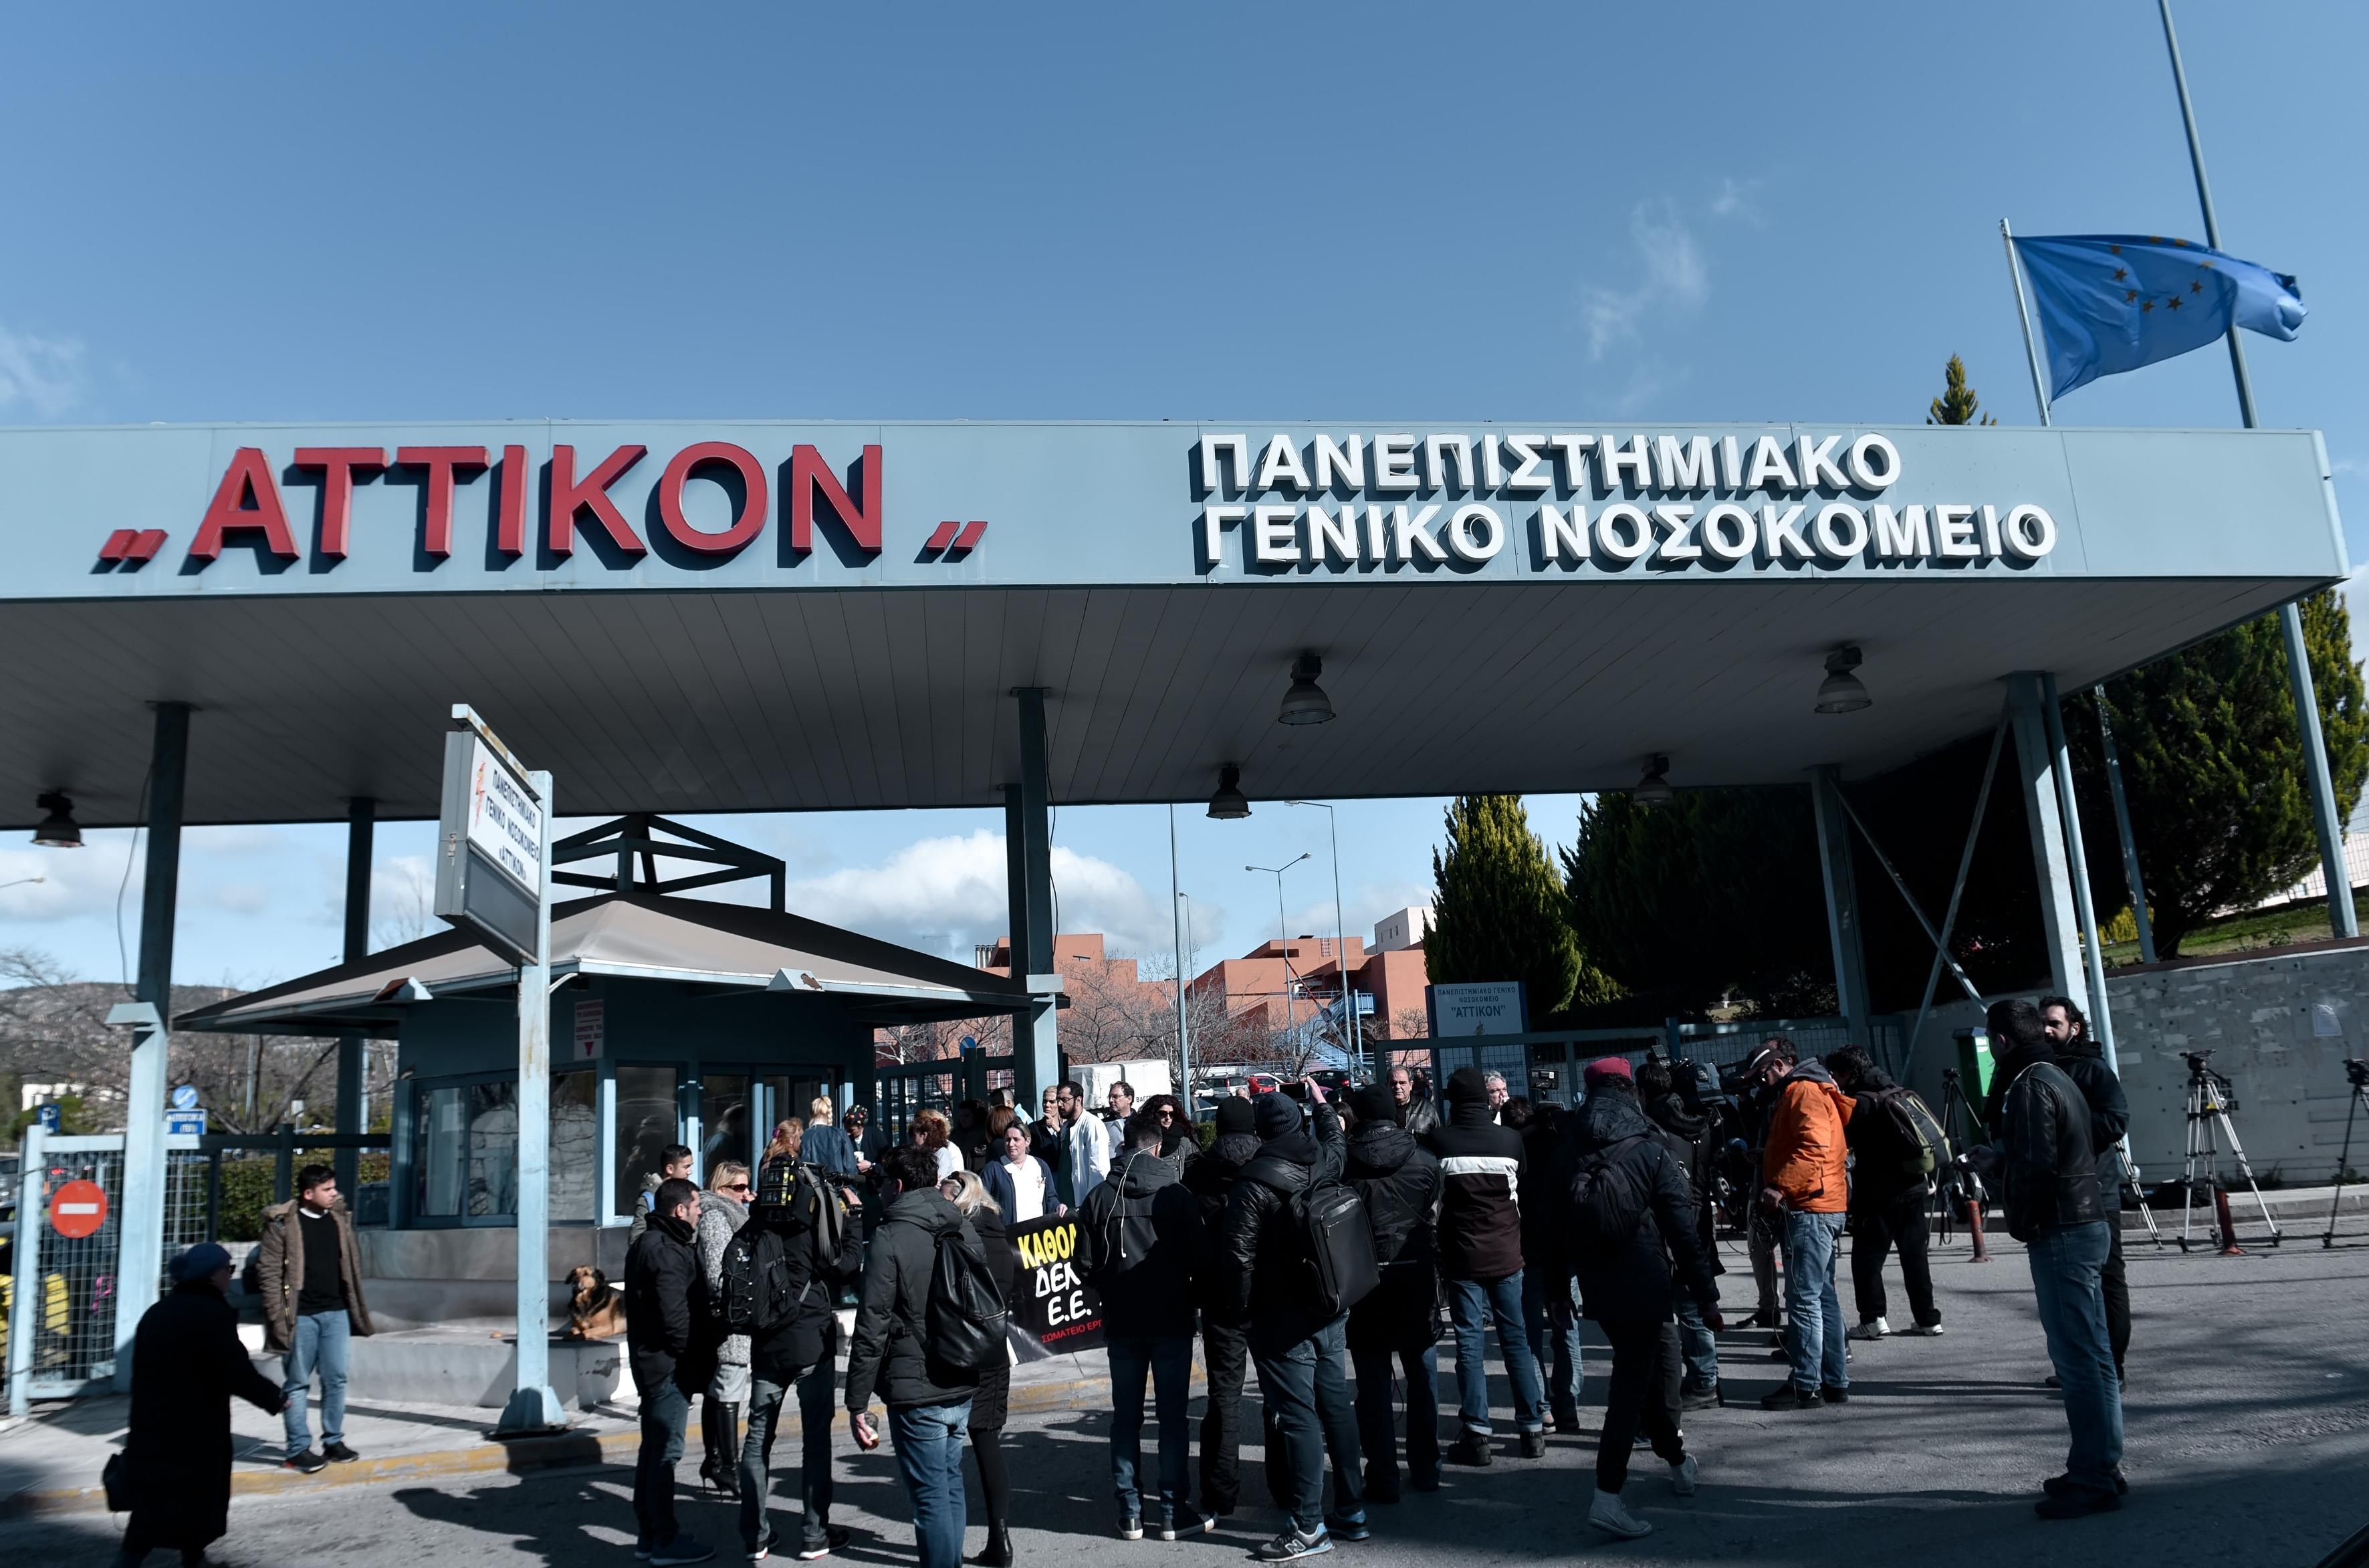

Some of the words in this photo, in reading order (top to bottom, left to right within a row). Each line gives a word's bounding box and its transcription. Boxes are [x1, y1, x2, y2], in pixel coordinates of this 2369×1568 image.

[1202, 433, 1900, 491] ΠΑΝΕΠΙΣΤΗΜΙΑΚΟ
[1206, 503, 1505, 563] ΓΕΝΙΚΟ
[1538, 503, 2058, 562] ΝΟΣΟΚΟΜΕΙΟ
[485, 795, 505, 830] ΓΕΝΙΚΟ
[1438, 988, 1492, 996] ΠΑΝΕΠΙΣΤΗΜΙΑΚΟ
[1041, 1324, 1086, 1343] ΣΩΜΑΤΕΙΟ
